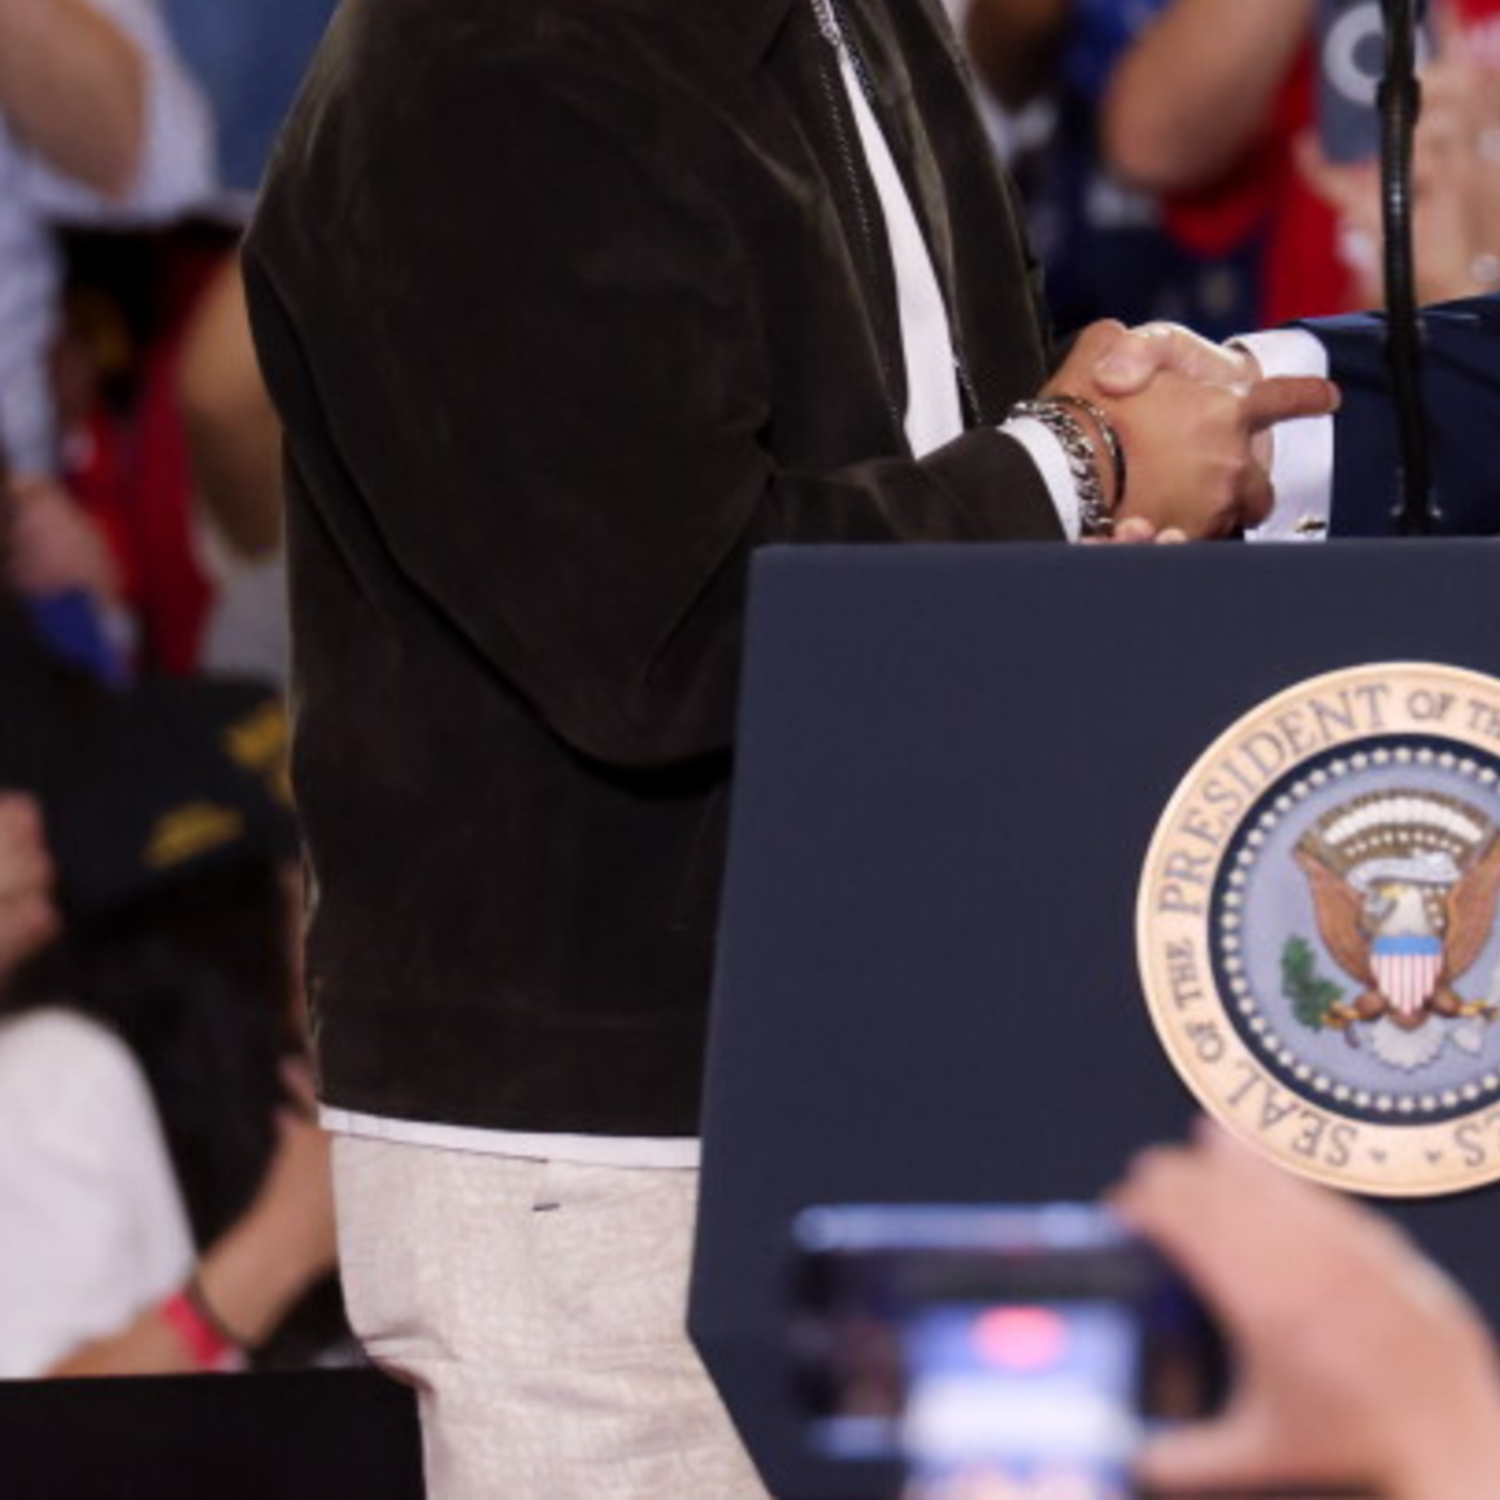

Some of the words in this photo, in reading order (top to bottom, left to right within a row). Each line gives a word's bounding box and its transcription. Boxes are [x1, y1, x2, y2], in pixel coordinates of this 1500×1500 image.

[1406, 688, 1458, 721] OF
[1159, 683, 1388, 915] PRESIDENT
[1164, 938, 1203, 1011] THE
[1186, 1021, 1225, 1063] OF
[1227, 1063, 1357, 1167] SEAL
